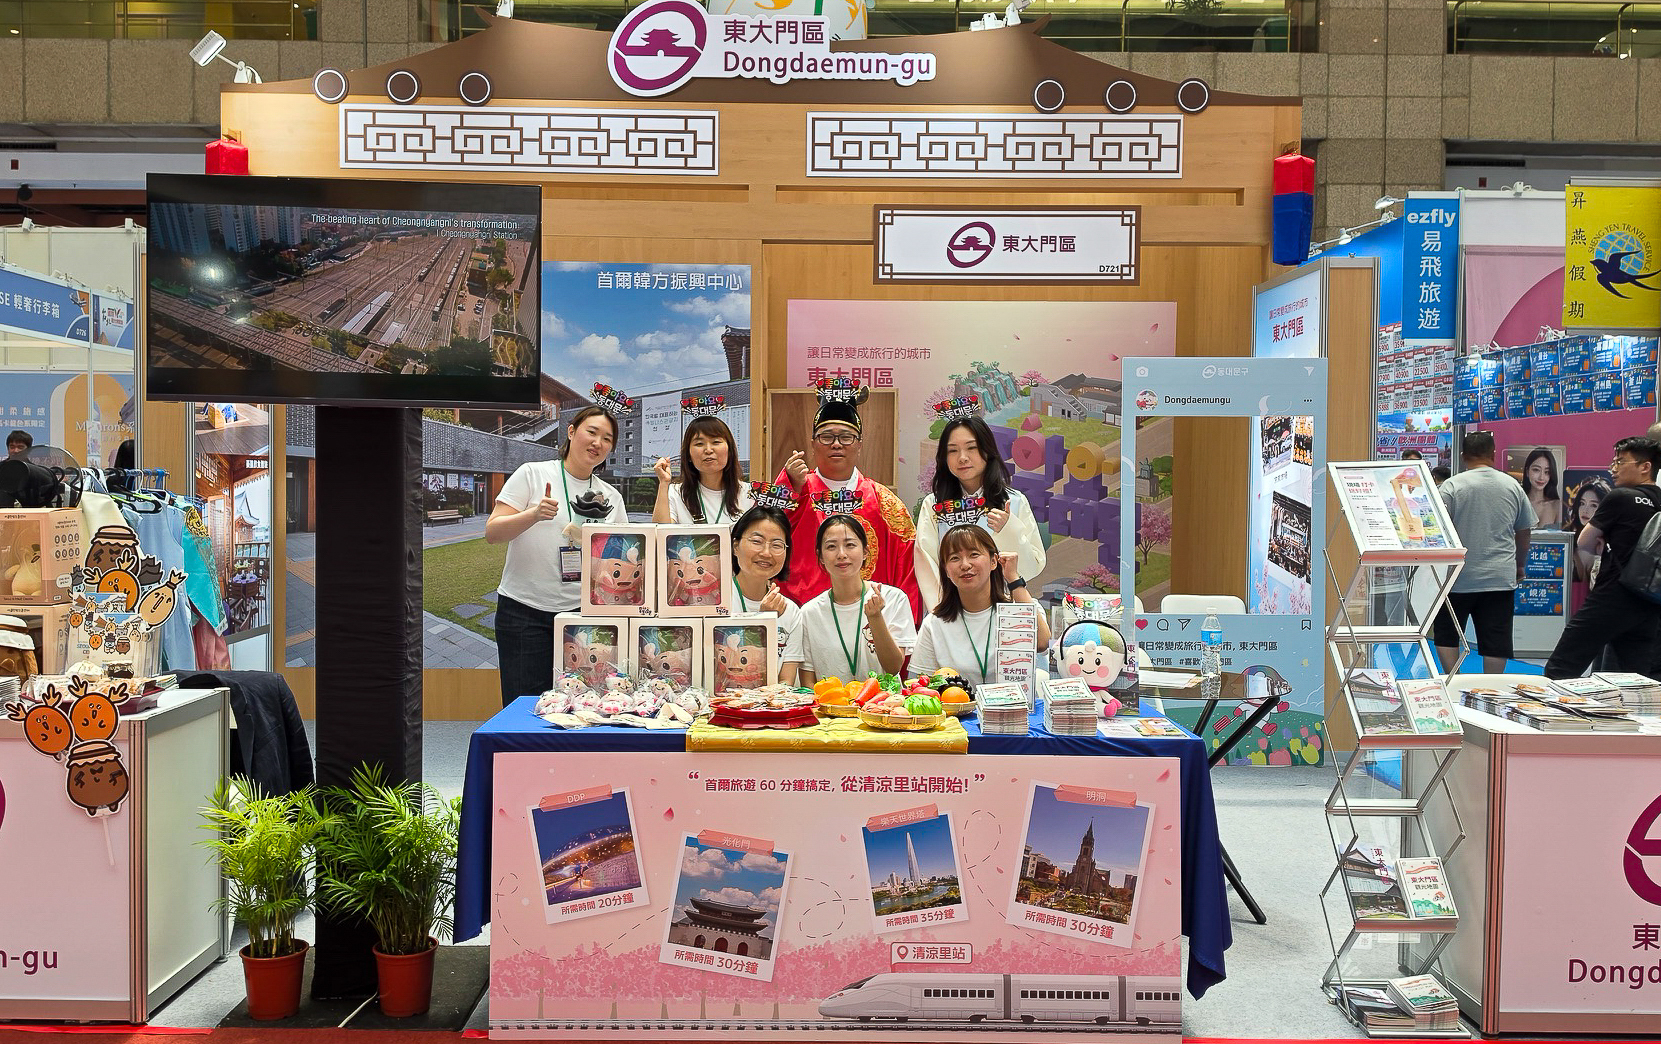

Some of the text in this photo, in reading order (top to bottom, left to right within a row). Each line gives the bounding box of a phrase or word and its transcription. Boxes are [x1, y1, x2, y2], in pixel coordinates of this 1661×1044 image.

[723, 19, 825, 45] 東大門區
[723, 51, 931, 78] Dongdaemun-gu
[311, 213, 326, 224] The
[327, 214, 357, 225] beating
[359, 215, 380, 225] heart
[382, 215, 391, 225] of
[1406, 208, 1457, 228] ezfly
[493, 230, 518, 240] Station
[1002, 234, 1076, 253] 東大門區
[1588, 223, 1653, 273] SHENG YEN TRAVEL SERVICE
[1568, 191, 1587, 319] 昇燕假期
[1099, 264, 1120, 273] D721
[597, 270, 743, 292] 首爾韓方振興中心
[1418, 230, 1442, 330] 易飛旅遊
[1272, 315, 1304, 343] 東大門區
[807, 346, 932, 360] 讓日常變成旅行的城市
[1217, 367, 1249, 377] 동대문구
[824, 388, 851, 402] 동대문
[1164, 395, 1231, 406] Dongdaemungu
[598, 395, 624, 414] 동대문
[691, 405, 717, 418] 동대문
[944, 405, 973, 419] 동대문
[758, 493, 787, 509] 동대문
[824, 502, 853, 515] 동대문
[945, 510, 977, 526] 동대문
[1239, 640, 1278, 651] 東大門區
[704, 779, 756, 792] 首爾旅遊
[759, 780, 776, 791] 60
[840, 775, 970, 794] 從清涼里站開始!
[567, 793, 586, 804] DDP
[1086, 790, 1107, 802] 明洞
[880, 809, 925, 826] 樂天世界塔
[722, 836, 751, 850] 光化門
[1410, 875, 1439, 883] 東大門區
[560, 892, 635, 916] 所需時間 20分鐘
[885, 909, 955, 928] 所需時間 35分鐘
[1024, 910, 1115, 940] 所需時間 30分鐘
[1632, 922, 1661, 951] 東
[912, 946, 966, 960] 清涼里站
[674, 949, 759, 975] 所需時間 30分鐘
